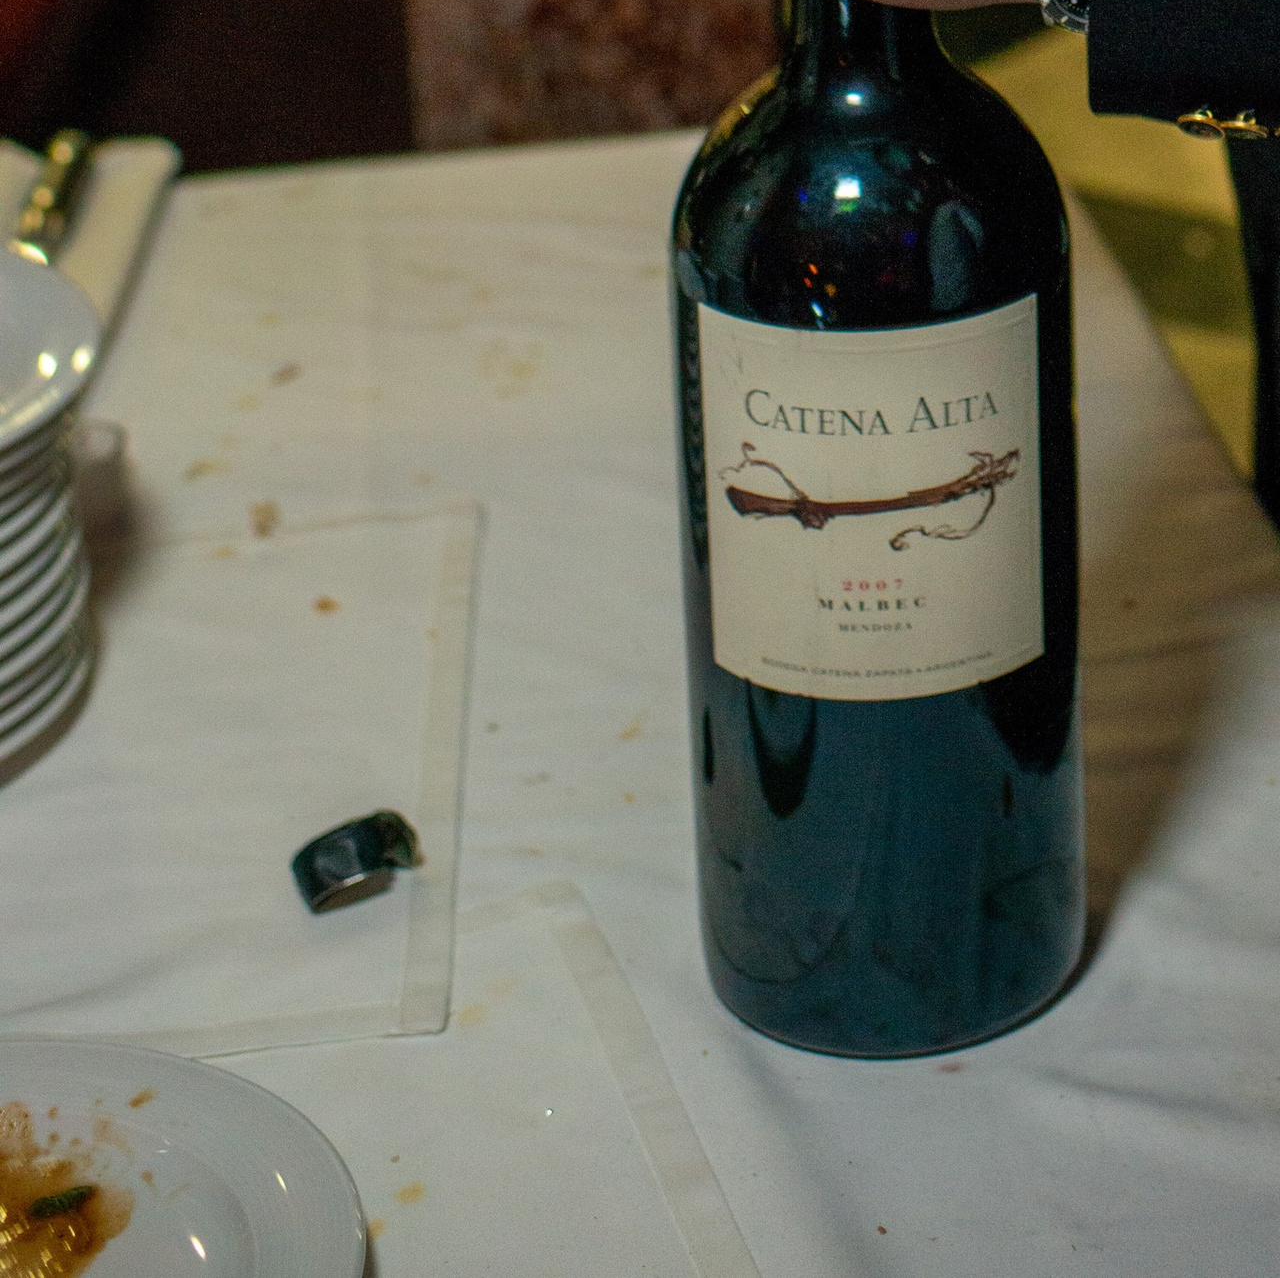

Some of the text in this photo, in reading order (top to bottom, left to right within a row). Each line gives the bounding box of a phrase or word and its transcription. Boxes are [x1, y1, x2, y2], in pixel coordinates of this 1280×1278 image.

[744, 388, 1000, 436] CATENA ALTA
[841, 577, 904, 592] 2007
[818, 597, 926, 611] MALBEC
